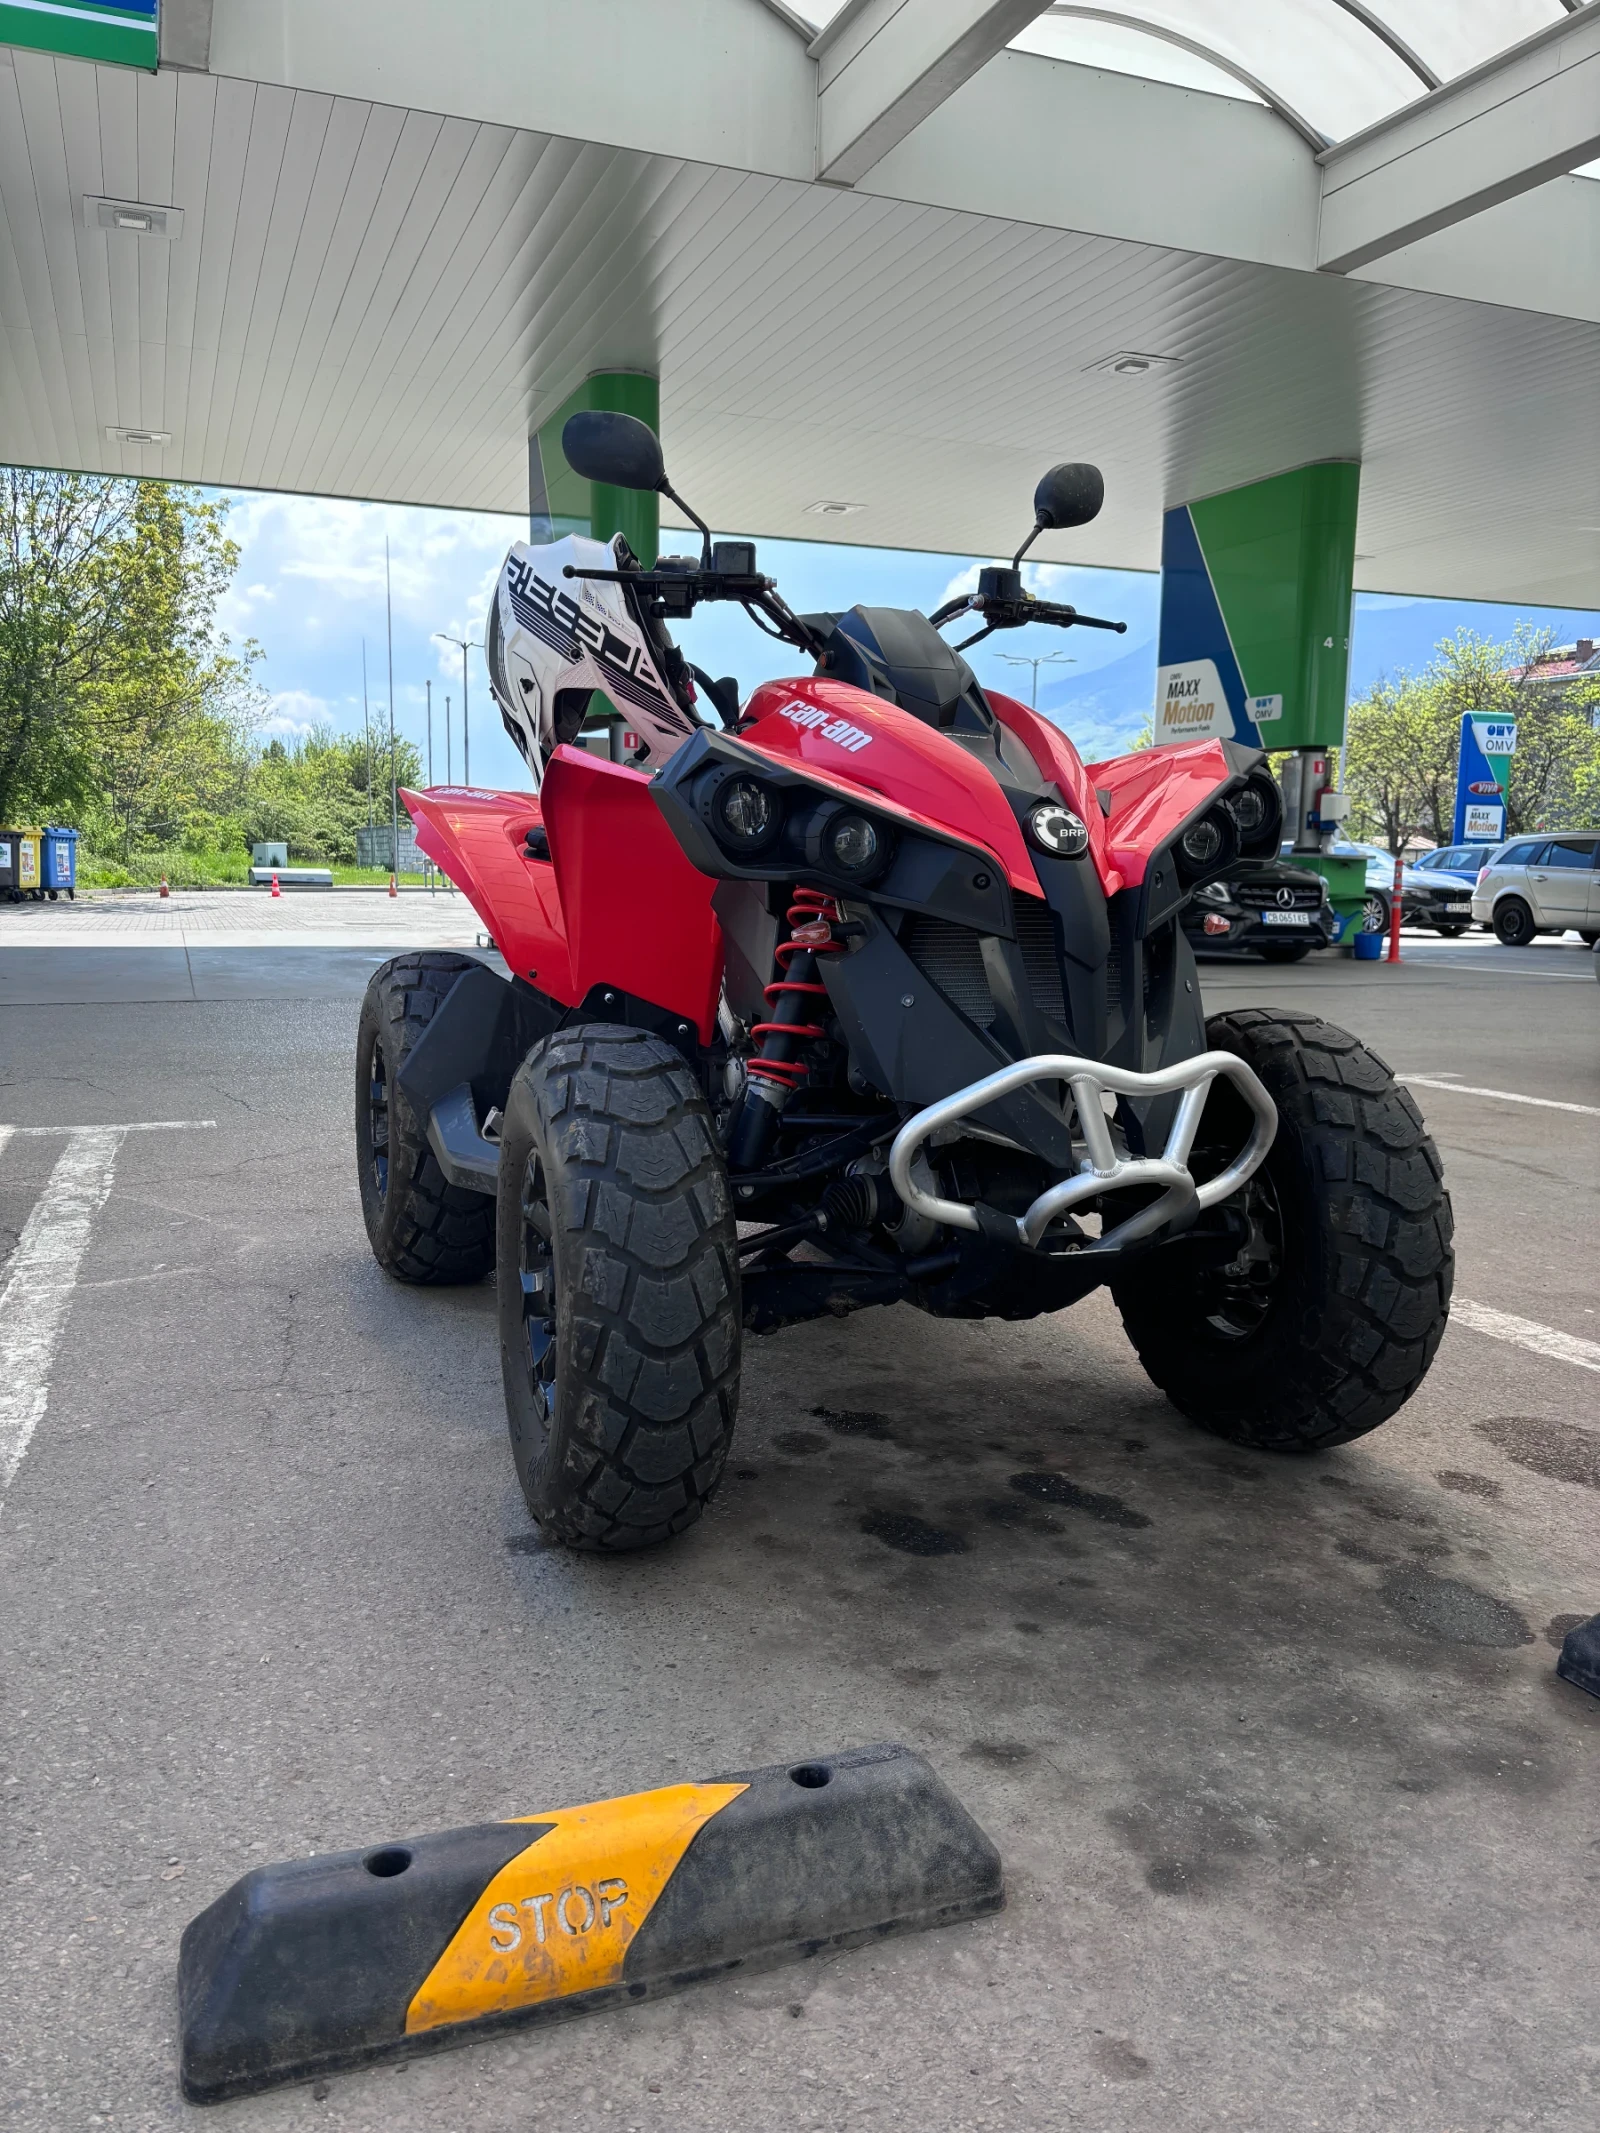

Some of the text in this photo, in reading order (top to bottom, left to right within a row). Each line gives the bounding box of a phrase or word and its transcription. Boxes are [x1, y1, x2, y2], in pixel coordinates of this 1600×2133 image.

[1323, 636, 1334, 649] 4
[1167, 679, 1202, 699] MAXX
[1163, 698, 1215, 726] Motion
[1254, 709, 1273, 720] OMV
[1485, 740, 1514, 752] OMV
[1478, 783, 1499, 793] VIVA
[1470, 812, 1491, 821] MAXX
[1467, 820, 1499, 833] Motion
[1060, 829, 1086, 837] BRP
[489, 1878, 629, 1953] STOP
